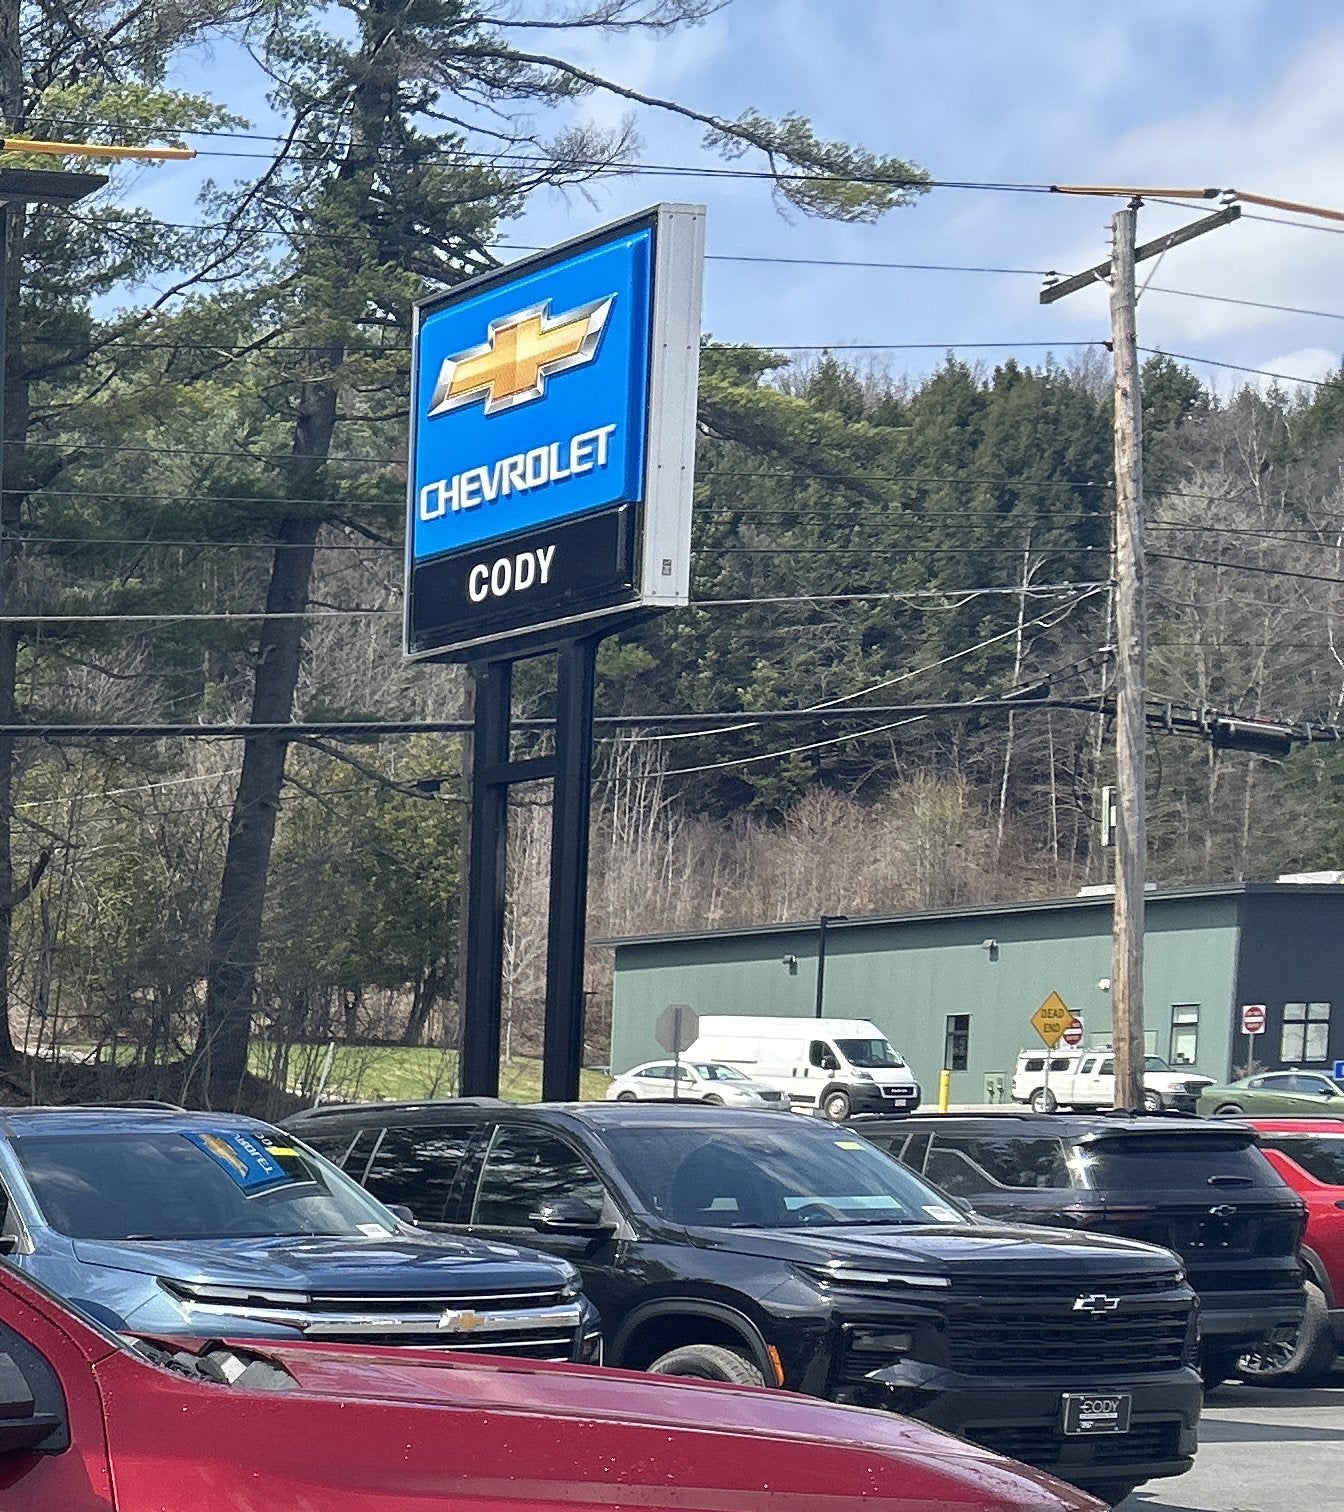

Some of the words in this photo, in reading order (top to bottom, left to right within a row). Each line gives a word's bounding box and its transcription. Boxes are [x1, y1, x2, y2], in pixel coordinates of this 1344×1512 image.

[419, 424, 617, 521] CHEVROLET
[469, 545, 556, 603] CODY
[1040, 1008, 1065, 1018] DEAD
[1043, 1022, 1061, 1033] END
[1082, 1400, 1120, 1413] CODY
